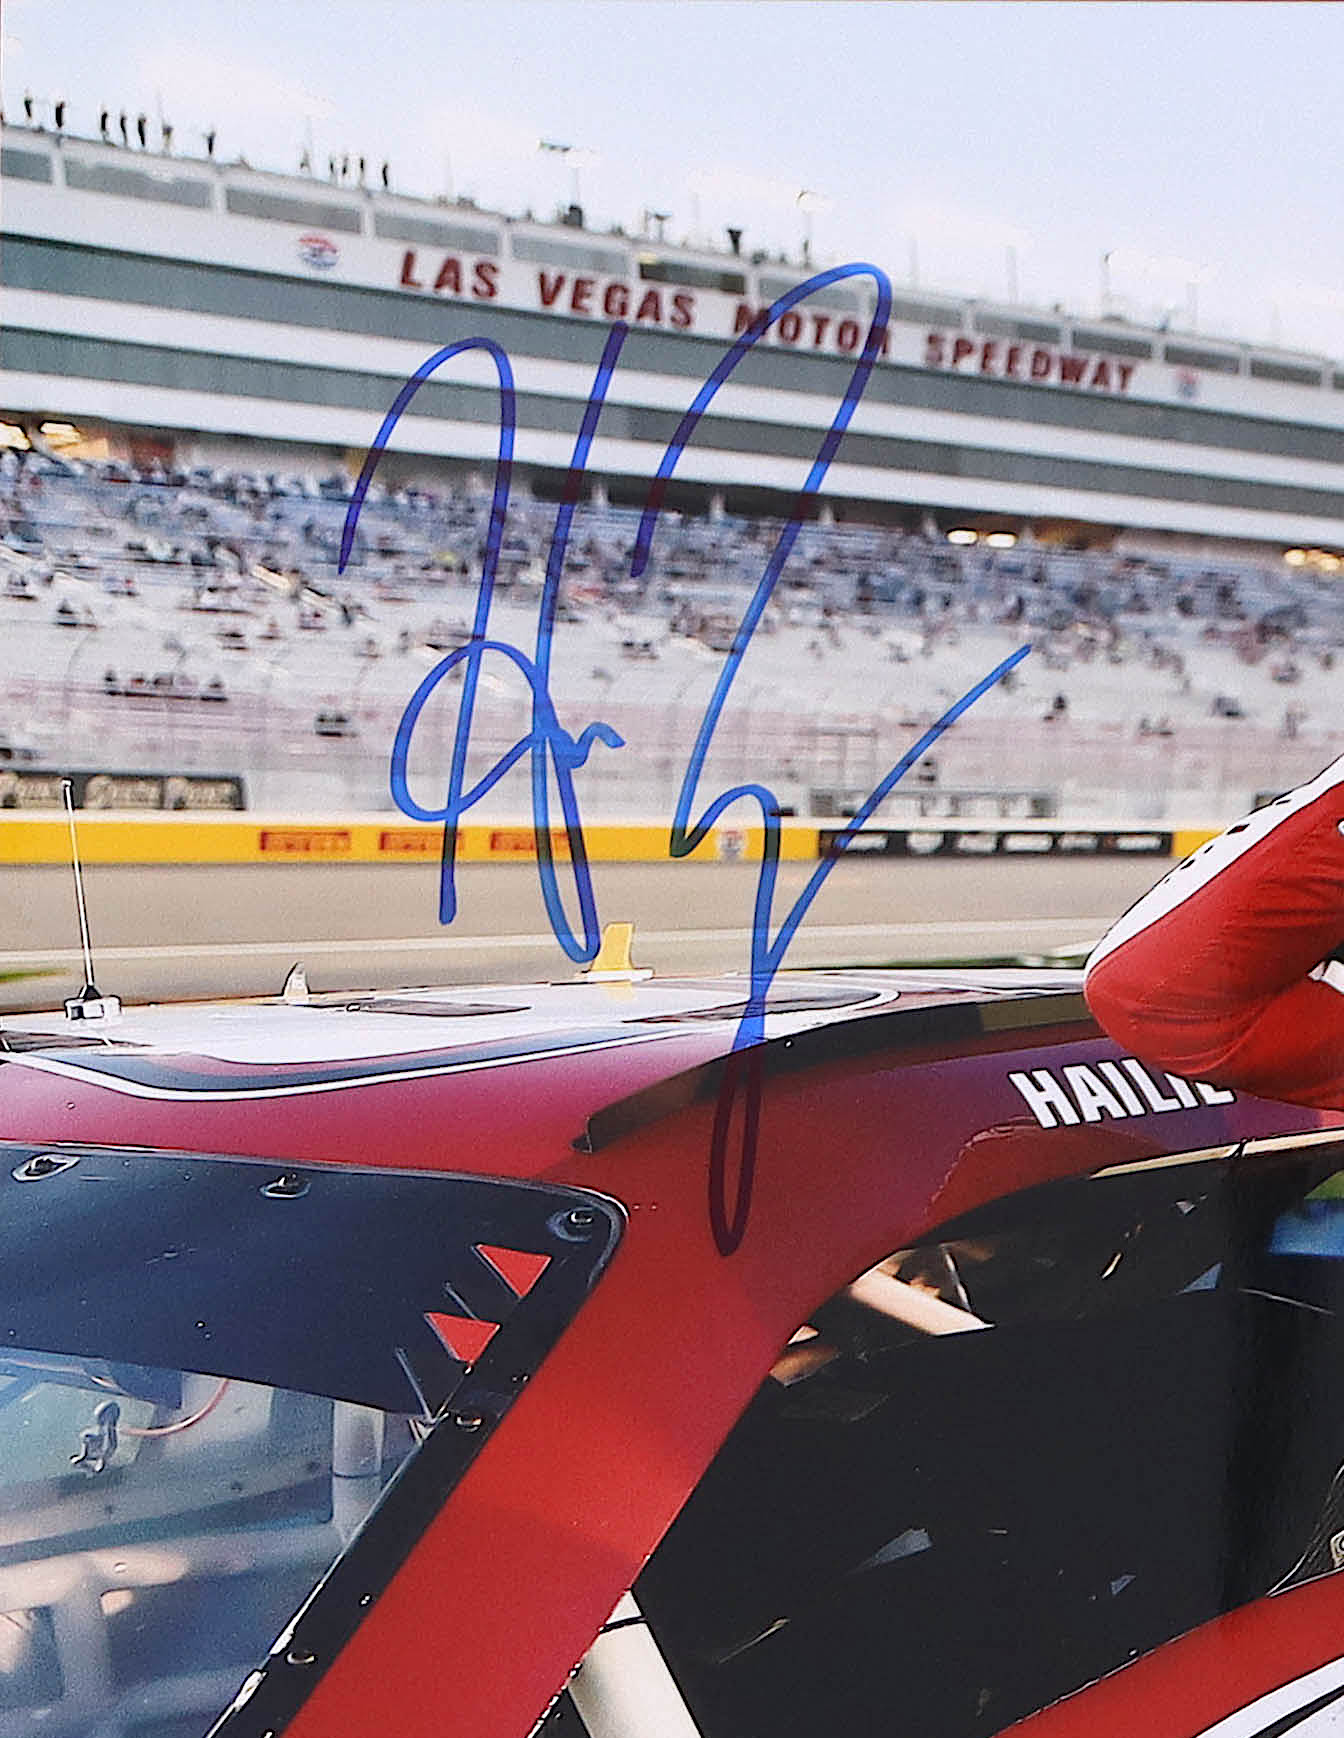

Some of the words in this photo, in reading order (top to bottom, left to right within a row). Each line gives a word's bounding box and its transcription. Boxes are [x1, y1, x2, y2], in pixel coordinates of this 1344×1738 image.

[400, 250, 499, 298] LAS
[538, 271, 695, 328] VEGAS
[926, 332, 1136, 394] SPEEDWAY
